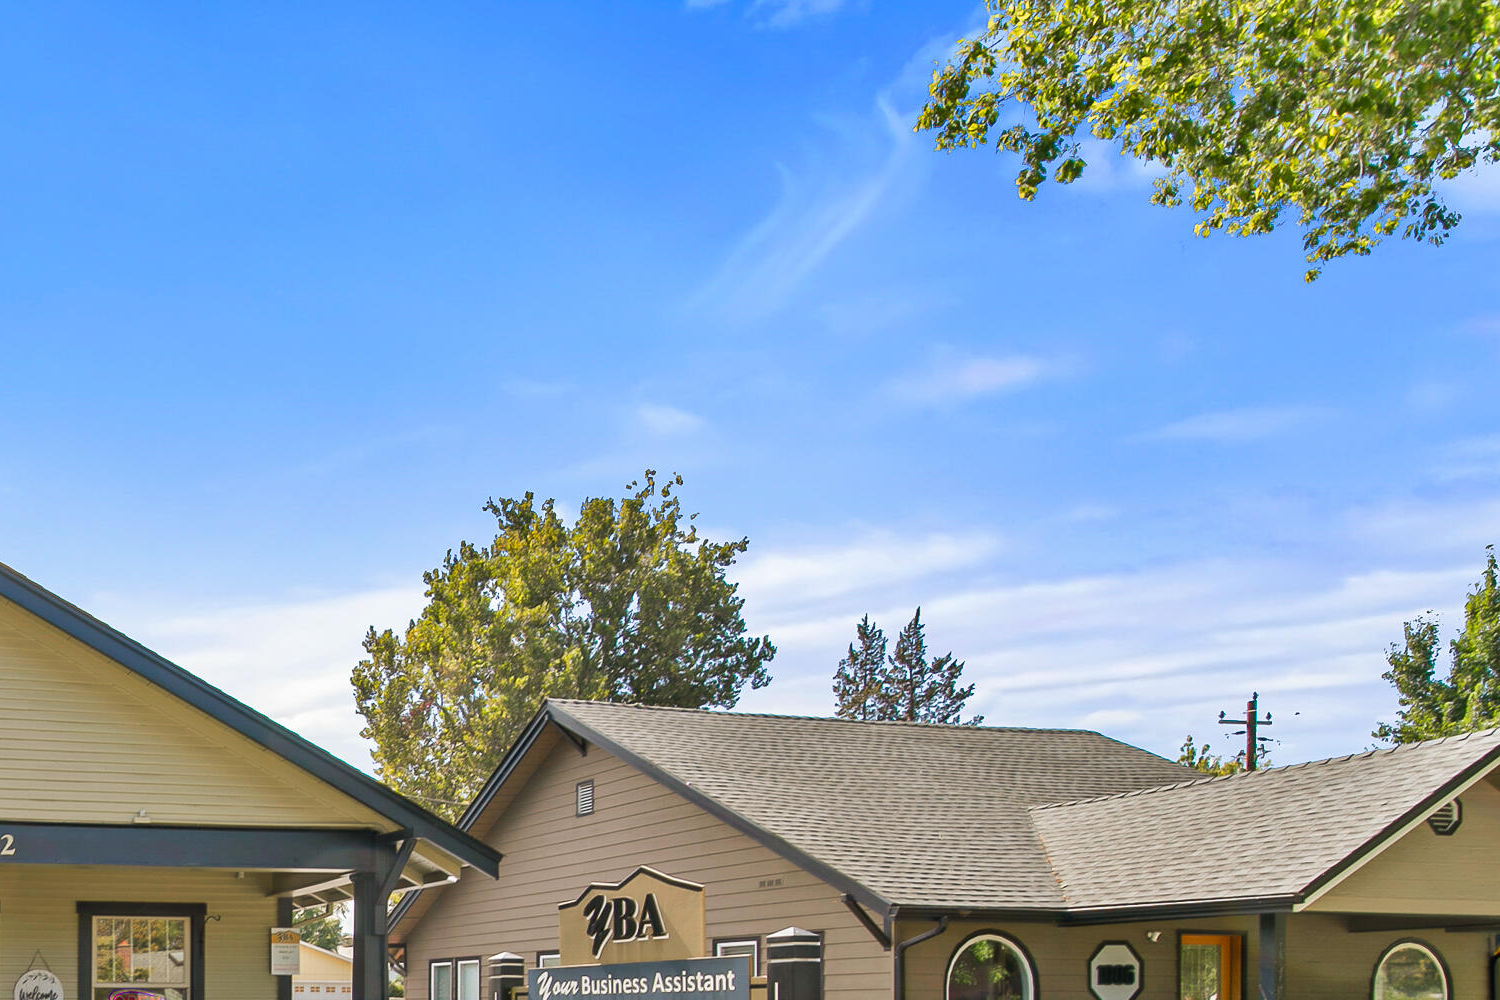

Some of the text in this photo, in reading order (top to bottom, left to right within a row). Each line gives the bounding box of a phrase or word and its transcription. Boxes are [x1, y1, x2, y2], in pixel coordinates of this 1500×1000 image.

[583, 893, 669, 959] YBA
[581, 973, 648, 996] Business
[652, 970, 736, 993] Assistant
